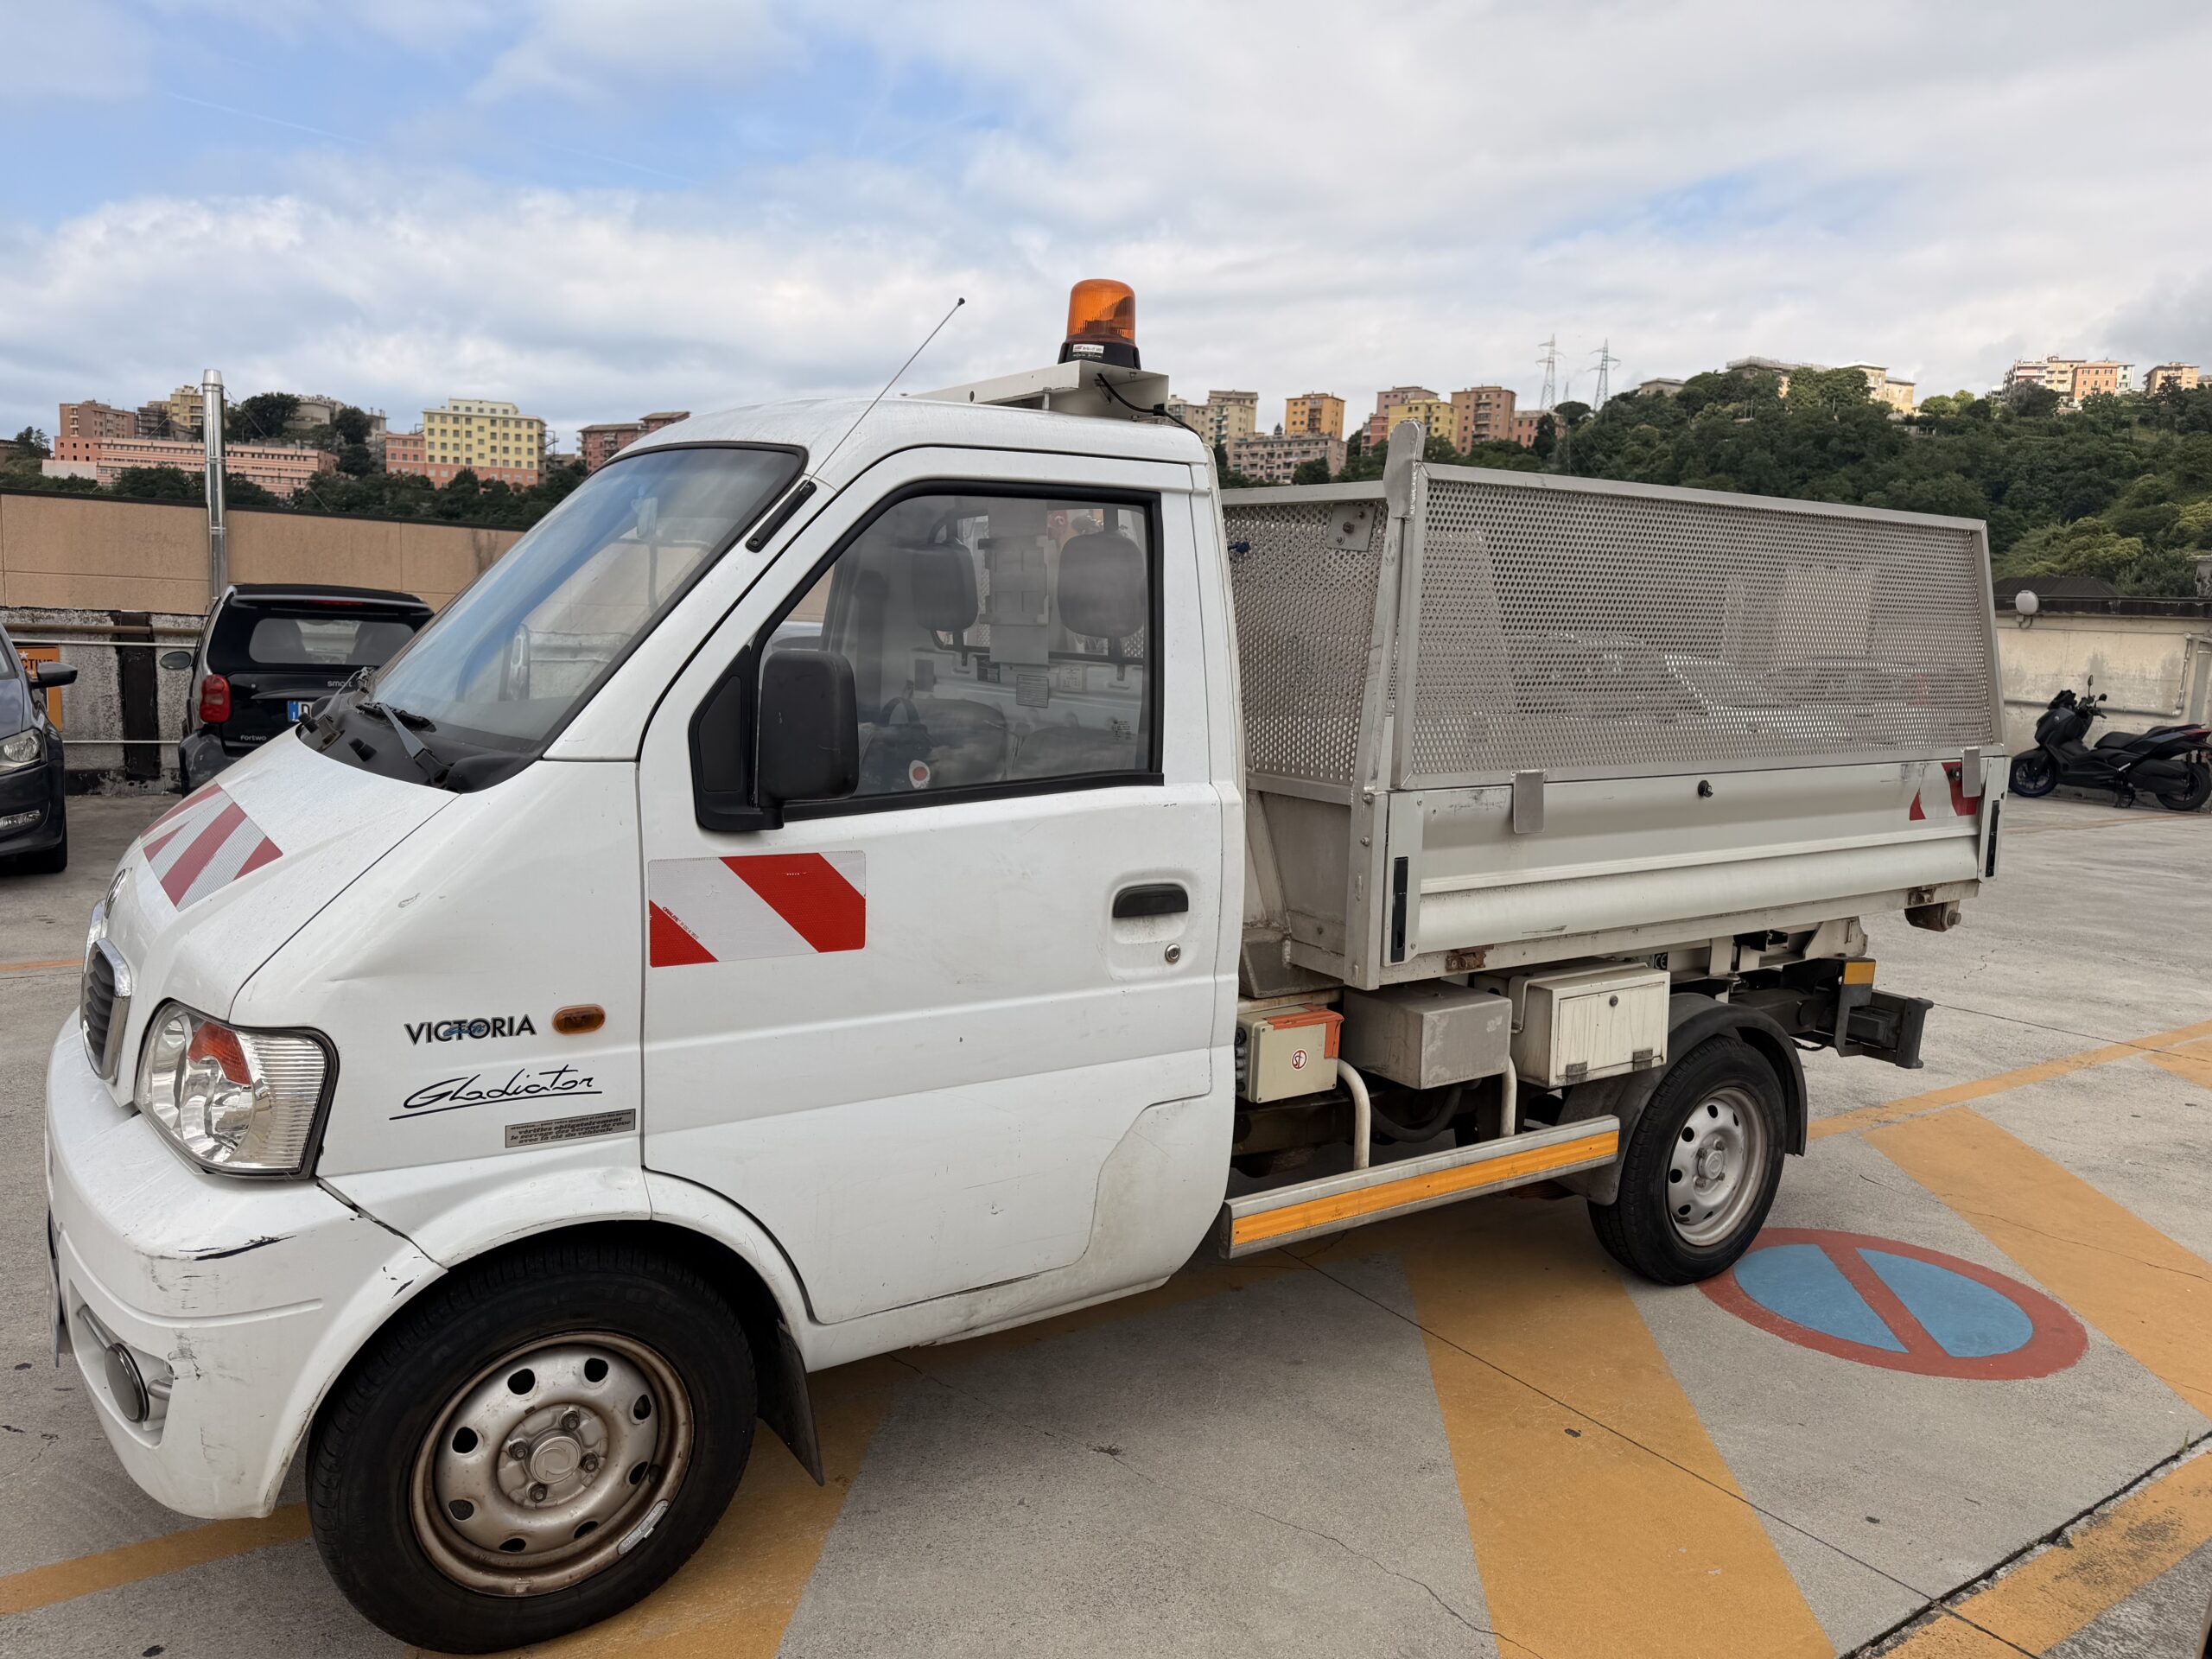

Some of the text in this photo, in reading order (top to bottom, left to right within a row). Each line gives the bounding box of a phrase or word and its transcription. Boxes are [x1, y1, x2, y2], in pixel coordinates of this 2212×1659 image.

[404, 1014, 537, 1046] VICTORIA
[403, 1064, 594, 1109] Gladiator
[518, 1116, 622, 1135] vérifiez obligatoirement
